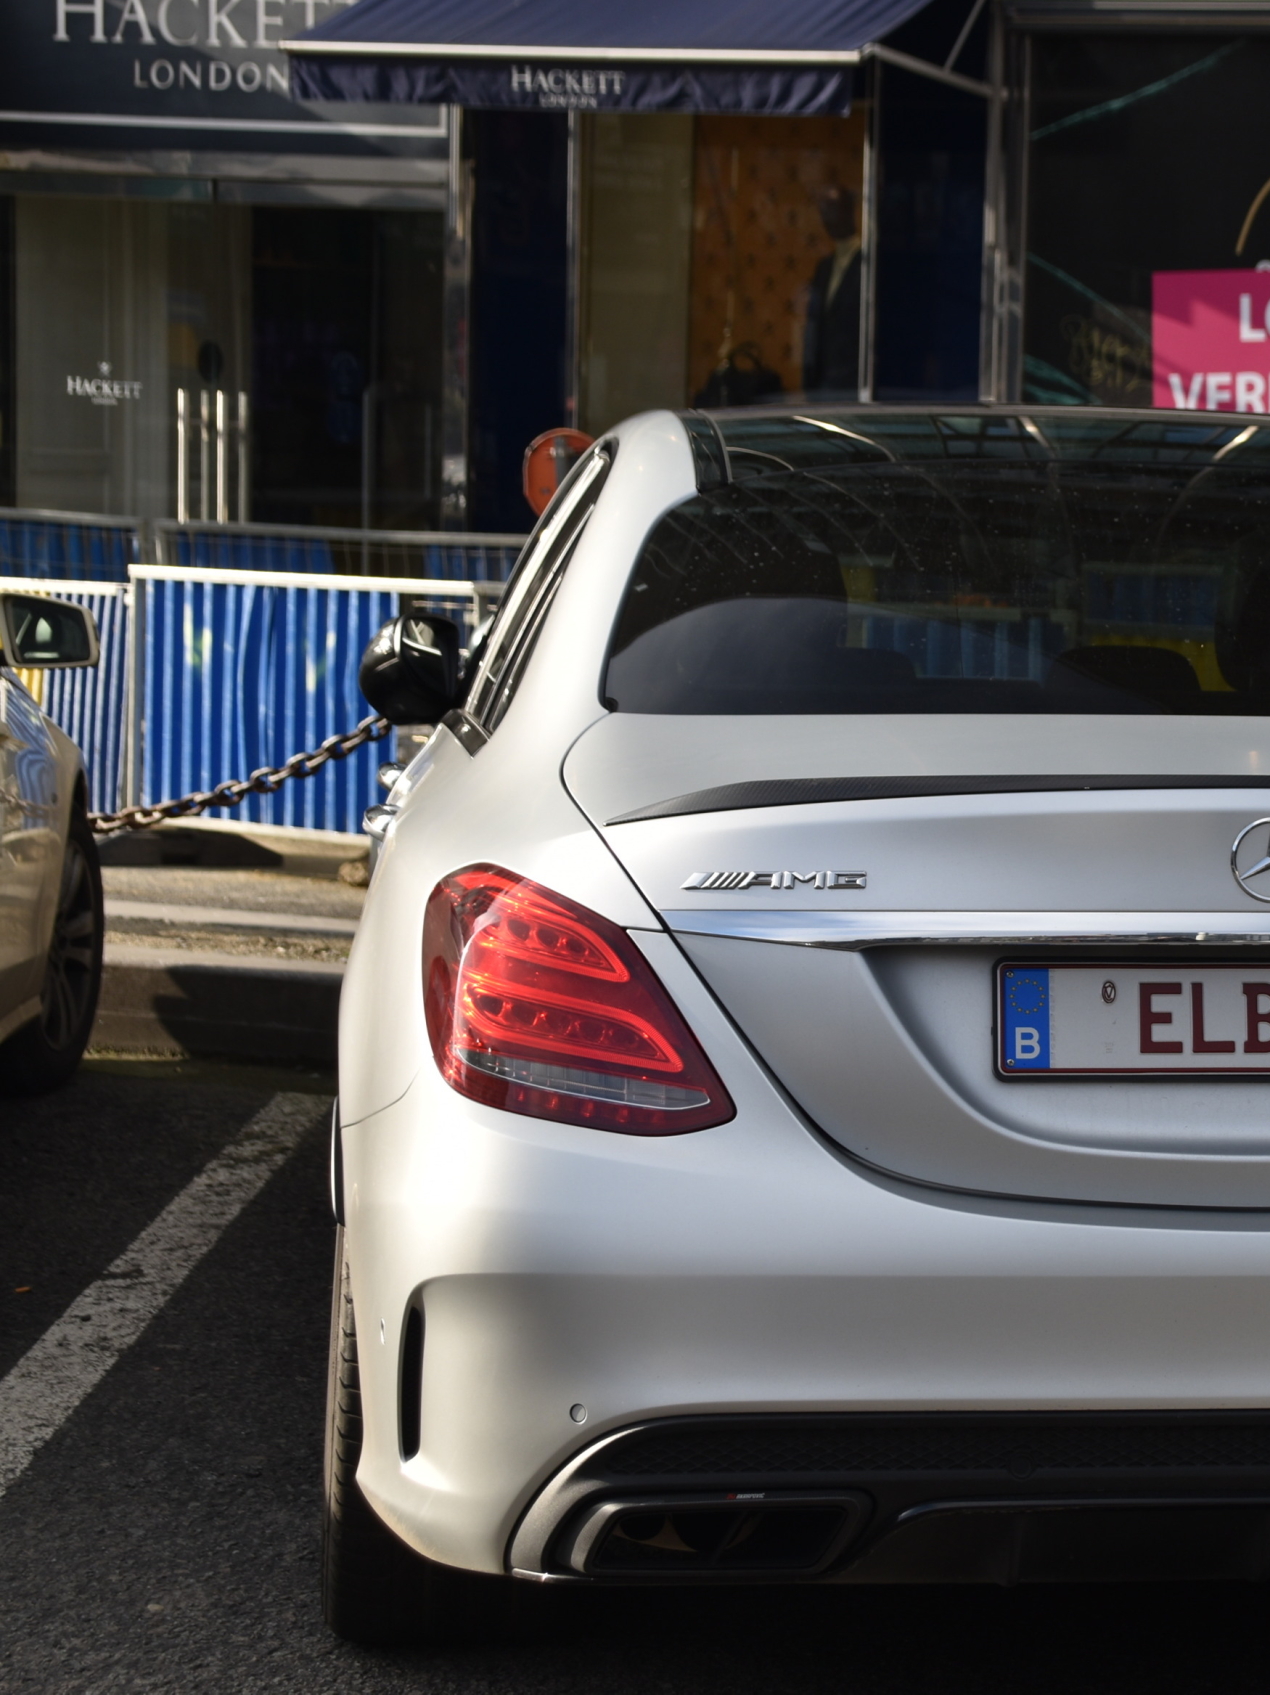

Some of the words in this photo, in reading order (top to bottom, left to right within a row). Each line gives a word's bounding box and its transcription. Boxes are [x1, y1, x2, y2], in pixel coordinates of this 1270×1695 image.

[133, 58, 290, 93] LONDON
[511, 65, 625, 95] HACKETT
[67, 375, 143, 400] HACKETT
[737, 871, 867, 890] AMG
[1014, 1027, 1041, 1060] B
